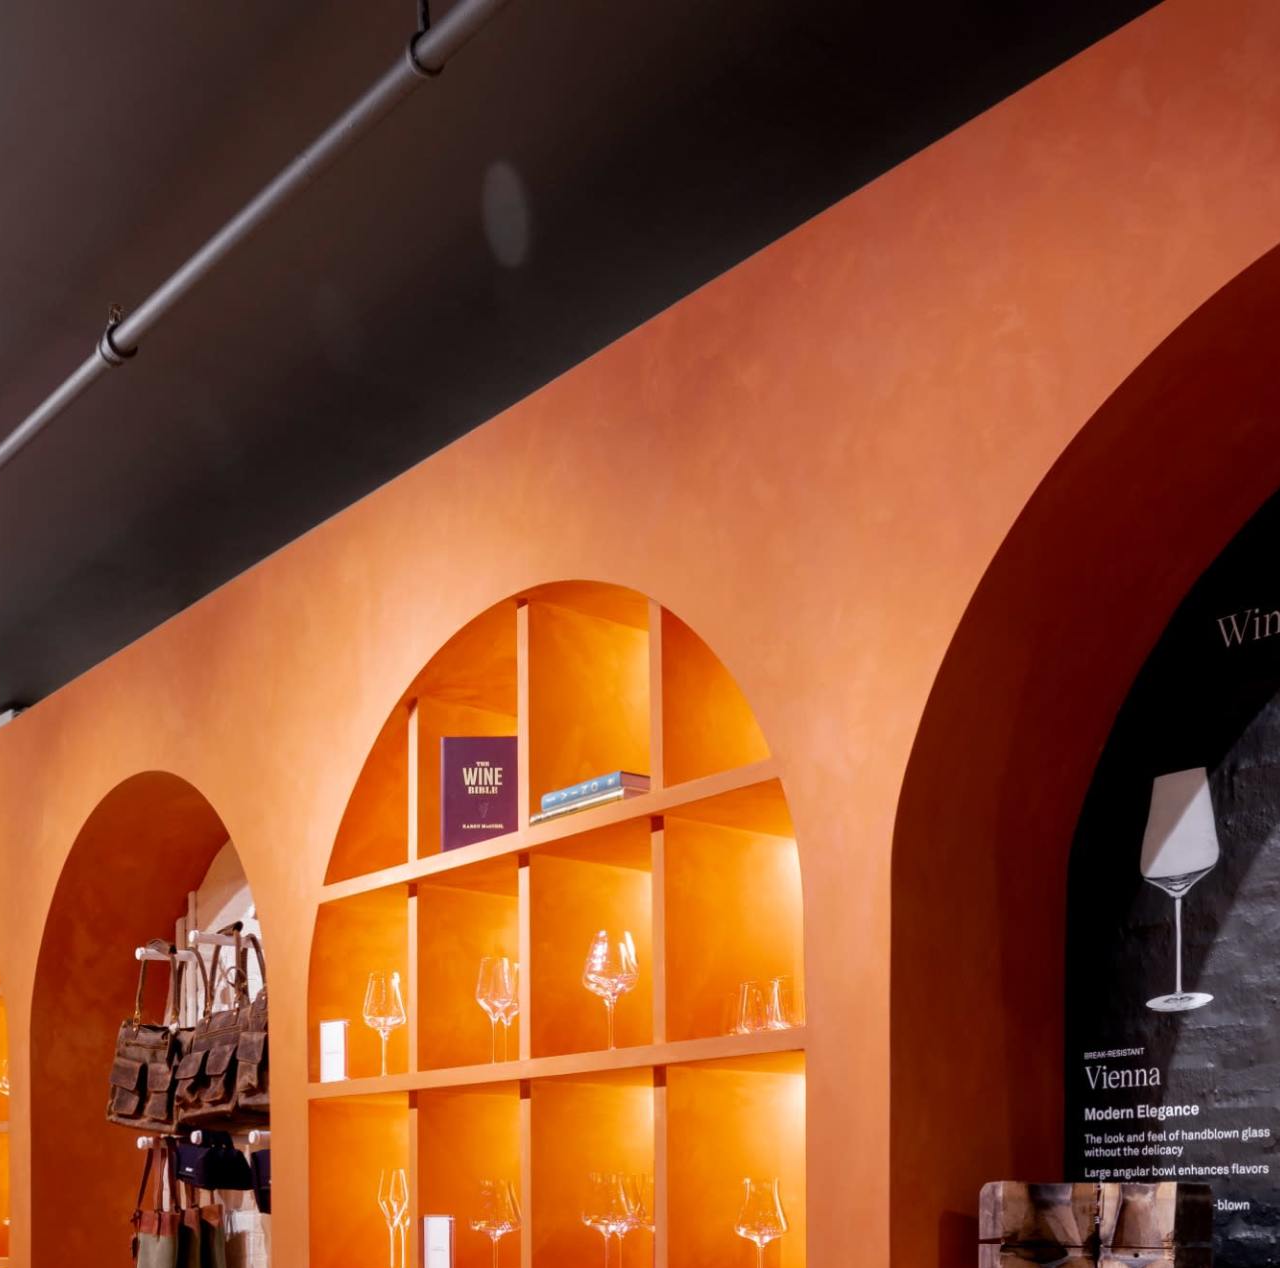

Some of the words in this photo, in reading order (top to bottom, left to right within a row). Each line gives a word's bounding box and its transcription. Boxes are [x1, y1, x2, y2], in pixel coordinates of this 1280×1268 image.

[462, 767, 503, 786] WINE
[468, 786, 498, 795] BIBLE
[1083, 1047, 1145, 1060] BREAK-RESISTANT
[1085, 1065, 1161, 1090] Vienna
[1084, 1107, 1134, 1121] Modern
[1137, 1103, 1200, 1121] Elegance
[1084, 1133, 1103, 1144] The
[1104, 1131, 1125, 1144] look
[1127, 1131, 1145, 1142] and
[1147, 1130, 1167, 1142] feel
[1169, 1130, 1180, 1141] of
[1181, 1128, 1239, 1141] handblown
[1241, 1127, 1271, 1140] glass
[1084, 1145, 1121, 1158] without
[1123, 1145, 1140, 1156] the
[1142, 1144, 1184, 1157] delicacy
[1084, 1166, 1112, 1179] Large
[1113, 1165, 1149, 1179] angular
[1152, 1164, 1176, 1176] bowl
[1178, 1164, 1230, 1176] enhances
[1231, 1162, 1270, 1174] flavors
